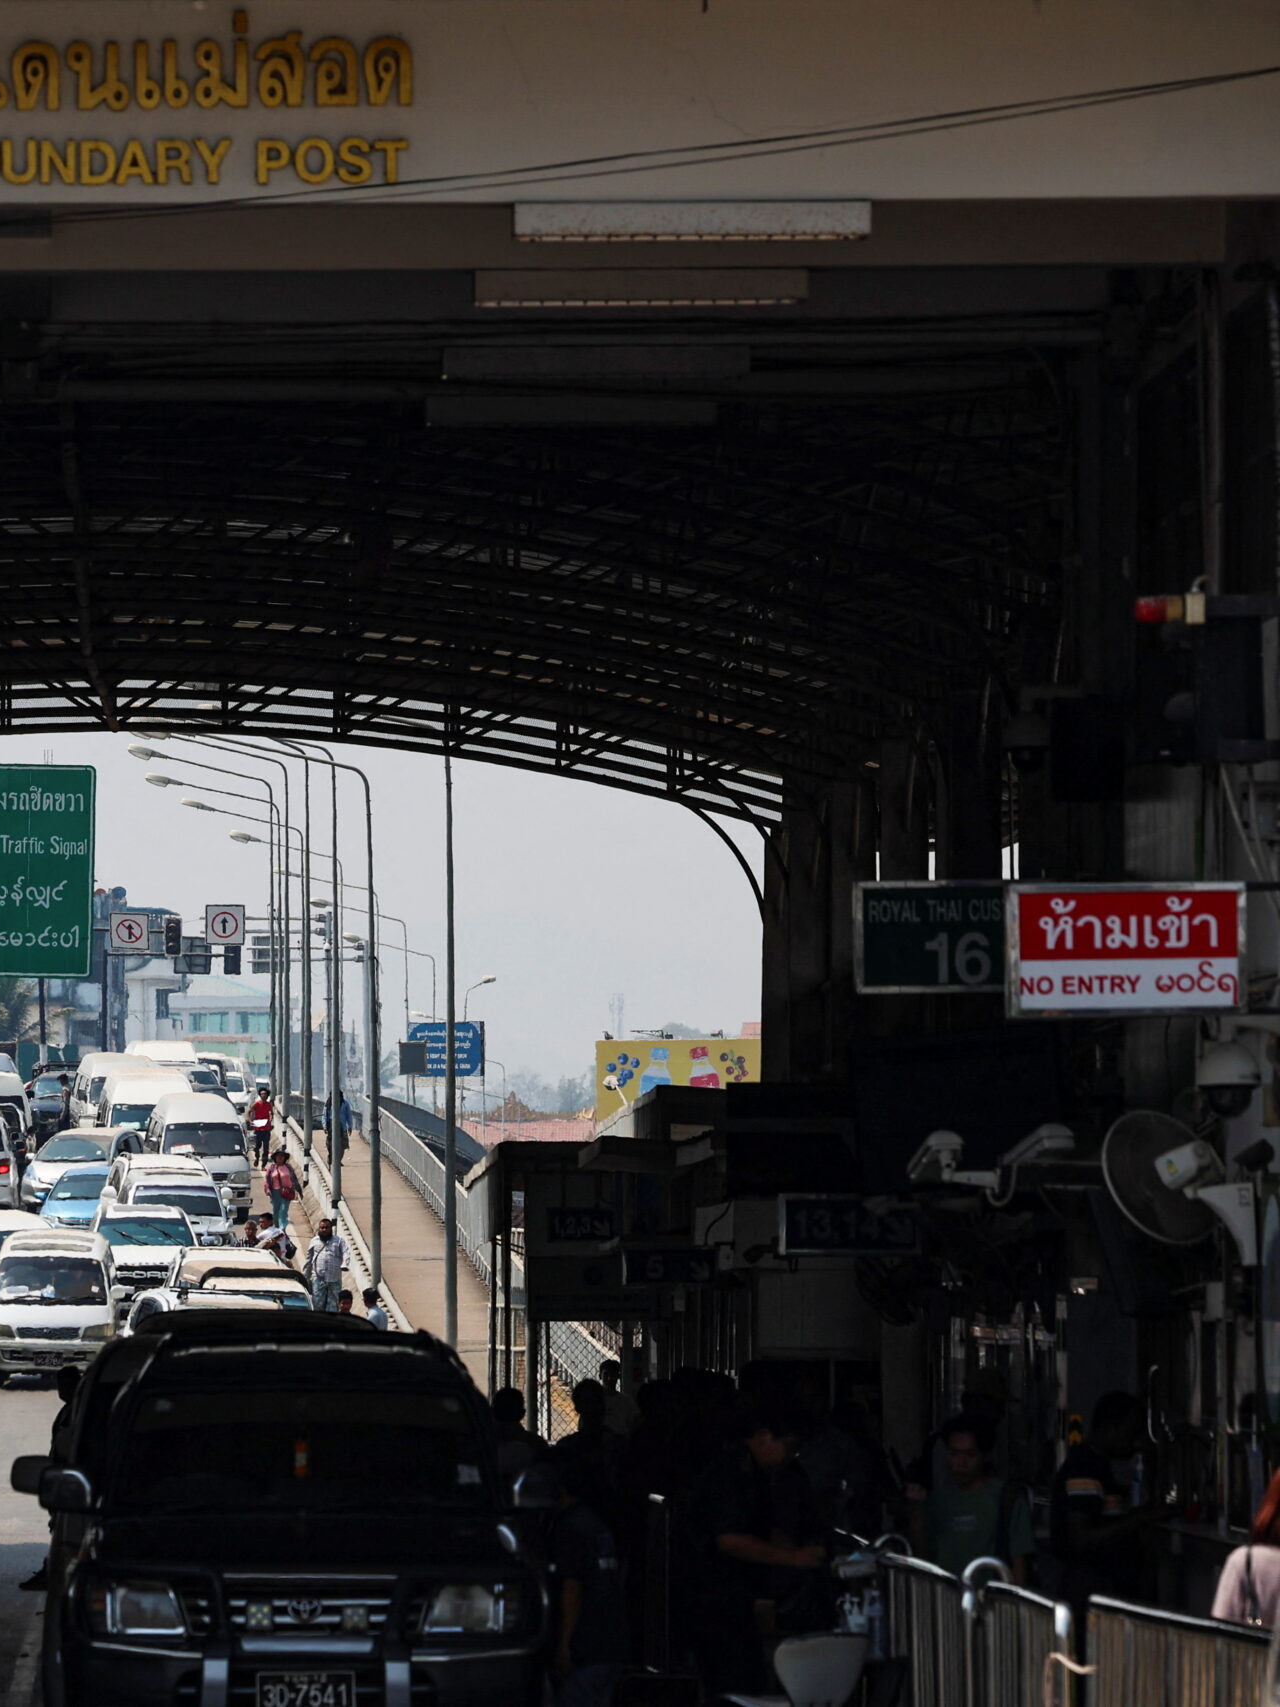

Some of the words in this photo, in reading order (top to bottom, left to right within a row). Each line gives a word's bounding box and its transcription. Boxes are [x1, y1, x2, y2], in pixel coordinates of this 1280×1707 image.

[256, 139, 410, 186] POST
[0, 834, 44, 855] Traffic
[49, 835, 88, 860] Signal
[867, 898, 920, 923] ROYAL
[926, 898, 962, 922] THAI
[1038, 896, 1219, 950] ห้ามเข้า
[924, 931, 991, 985] 16
[1020, 976, 1054, 996] NO
[1062, 974, 1141, 995] ENTRY
